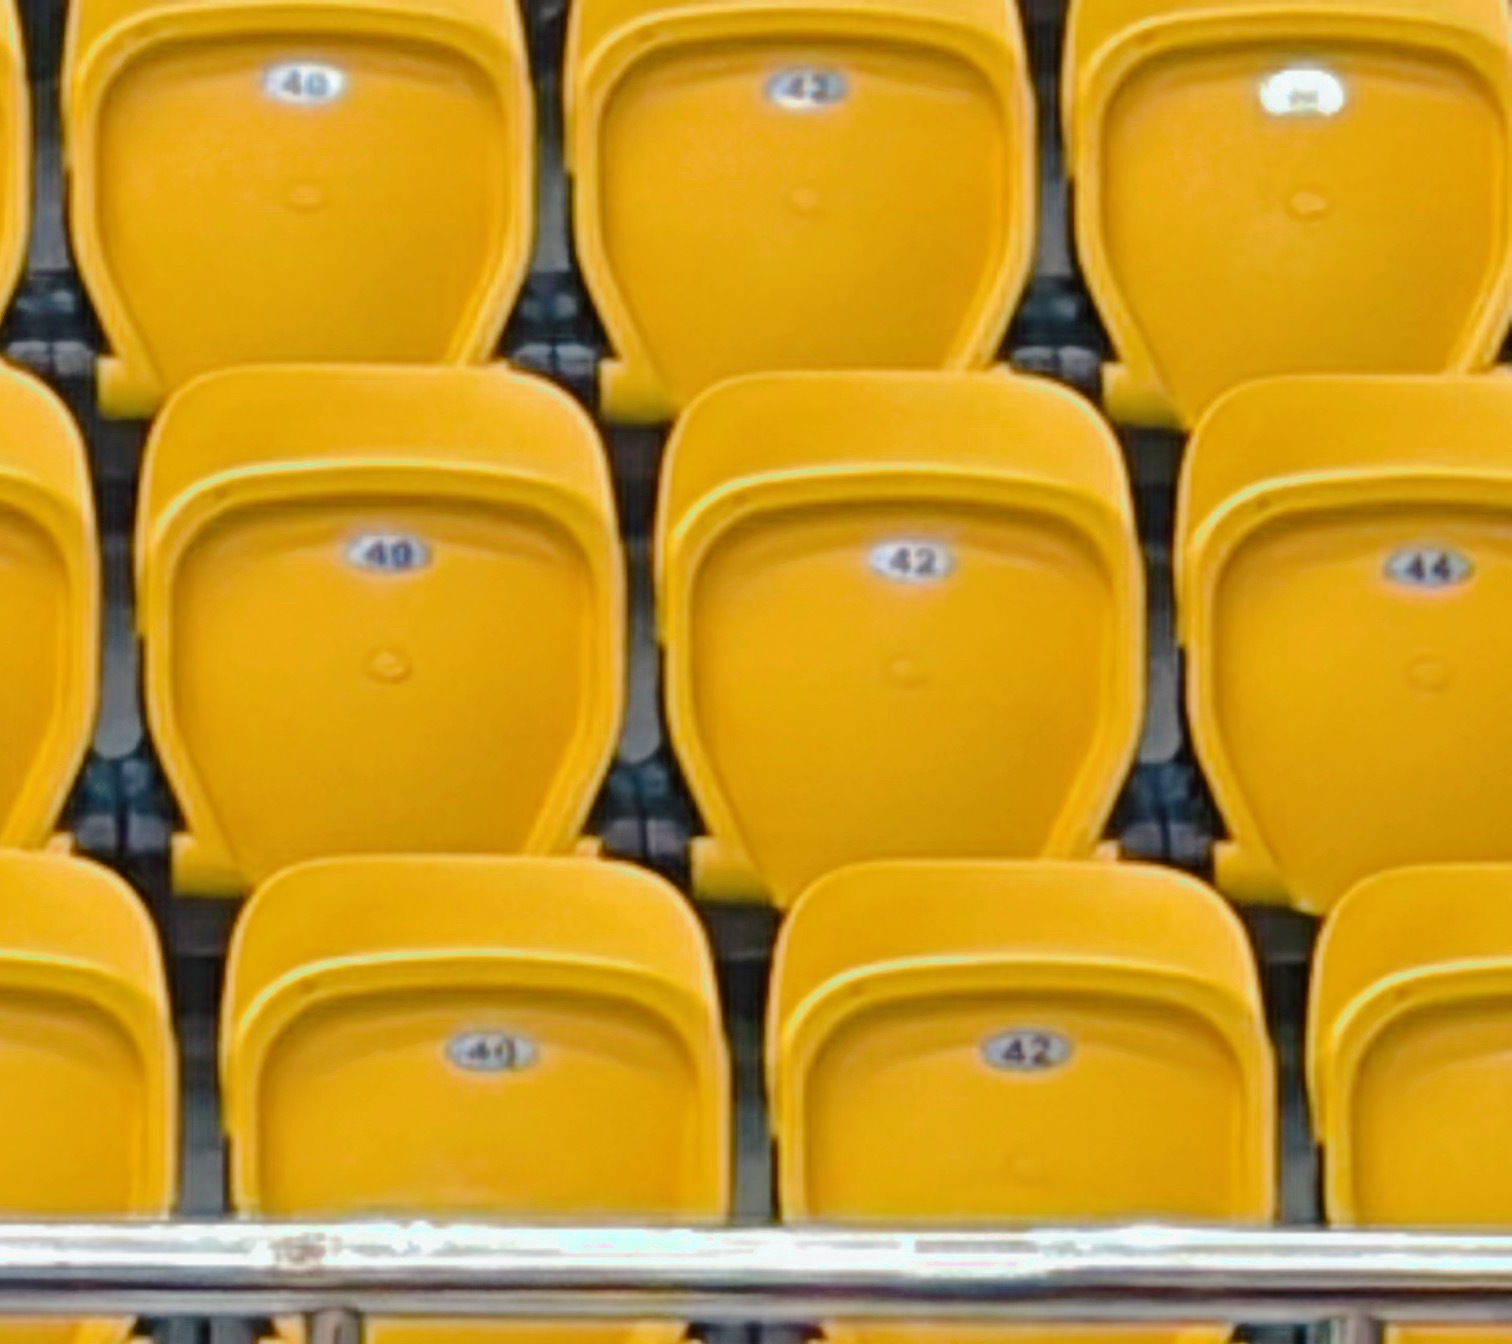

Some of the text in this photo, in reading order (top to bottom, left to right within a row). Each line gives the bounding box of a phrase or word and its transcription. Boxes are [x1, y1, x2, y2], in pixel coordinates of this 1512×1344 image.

[889, 547, 937, 575] 42
[1405, 553, 1452, 581] 44
[1002, 1037, 1052, 1066] 42
